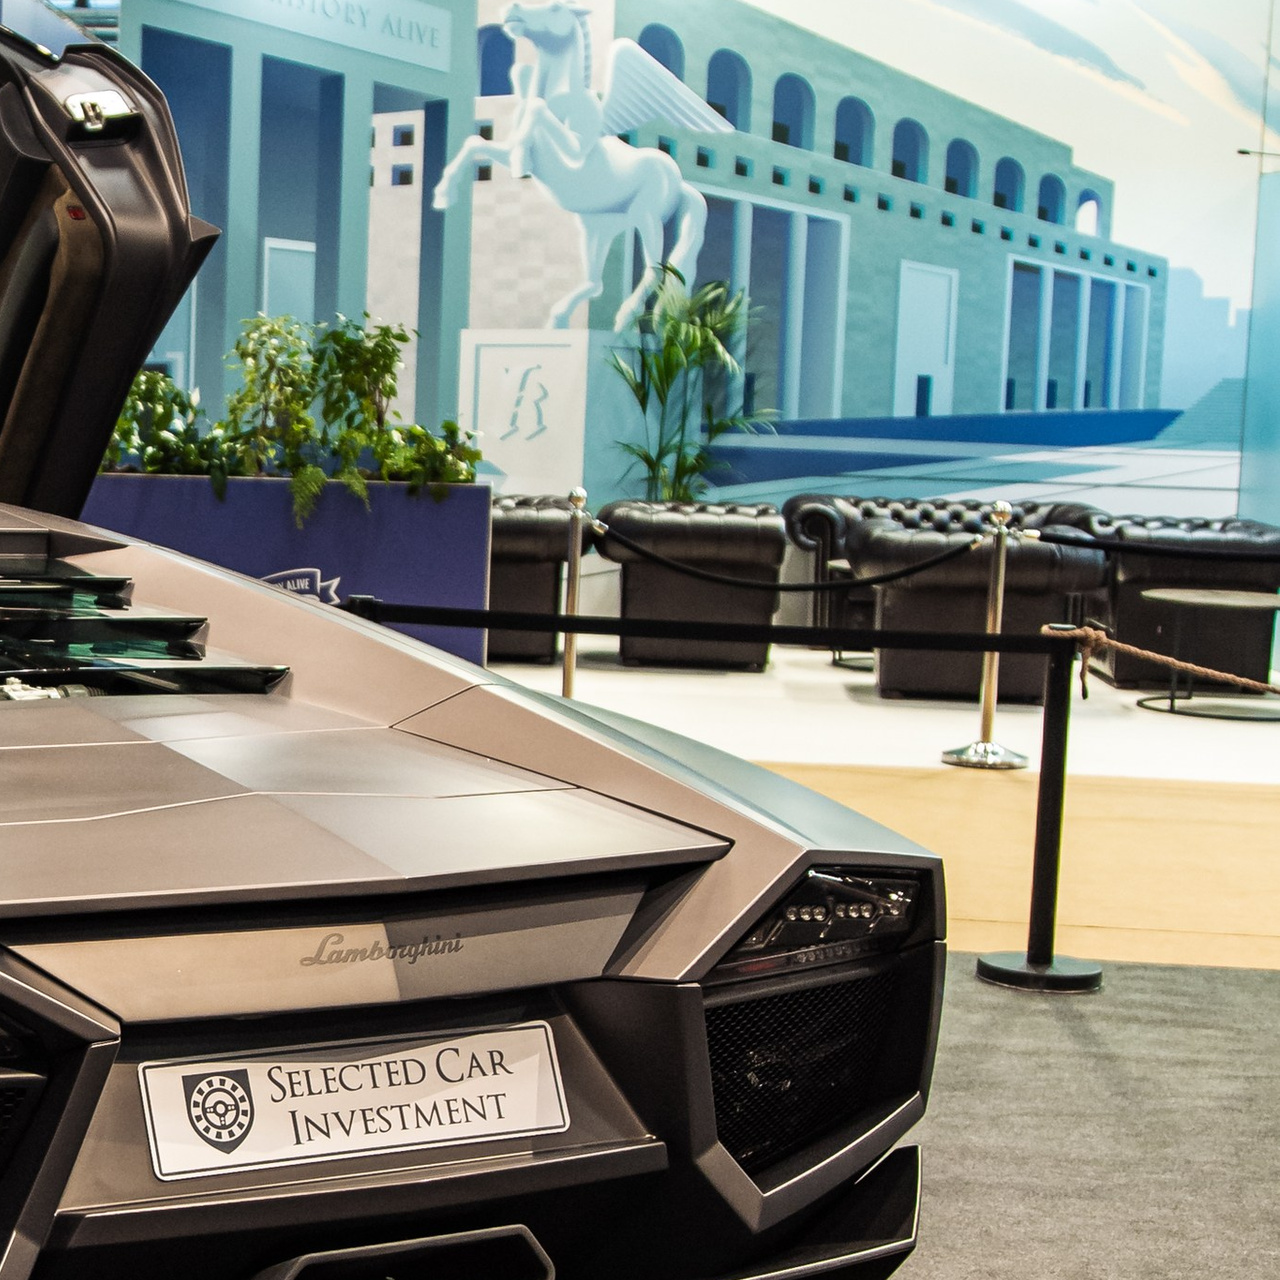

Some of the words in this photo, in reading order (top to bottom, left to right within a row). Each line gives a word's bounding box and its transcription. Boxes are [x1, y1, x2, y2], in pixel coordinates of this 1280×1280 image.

[380, 13, 440, 49] ALIVE
[286, 578, 311, 591] ALIVE
[299, 932, 465, 967] Lamborghini
[267, 1058, 427, 1104] SELECTED
[435, 1047, 514, 1084] CAR
[288, 1092, 507, 1146] INVESTMENT
